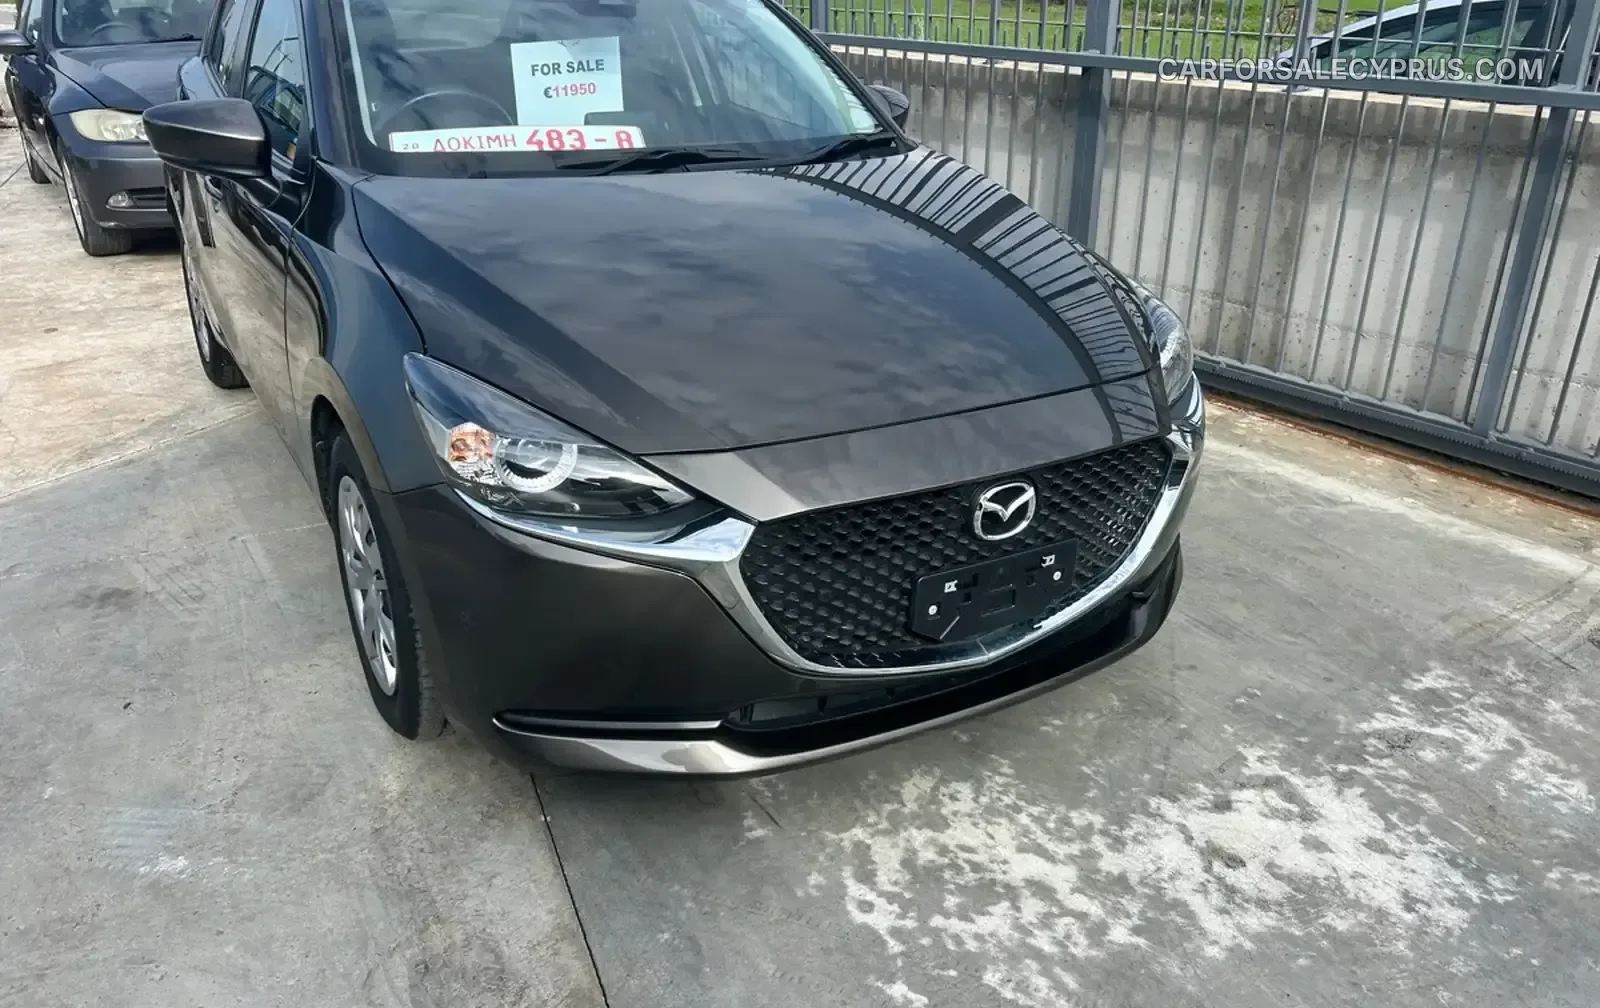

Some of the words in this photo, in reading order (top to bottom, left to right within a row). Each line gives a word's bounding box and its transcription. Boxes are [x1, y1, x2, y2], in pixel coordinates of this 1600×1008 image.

[530, 62, 562, 77] FOR
[566, 59, 605, 74] SALE
[543, 82, 597, 99] €11950
